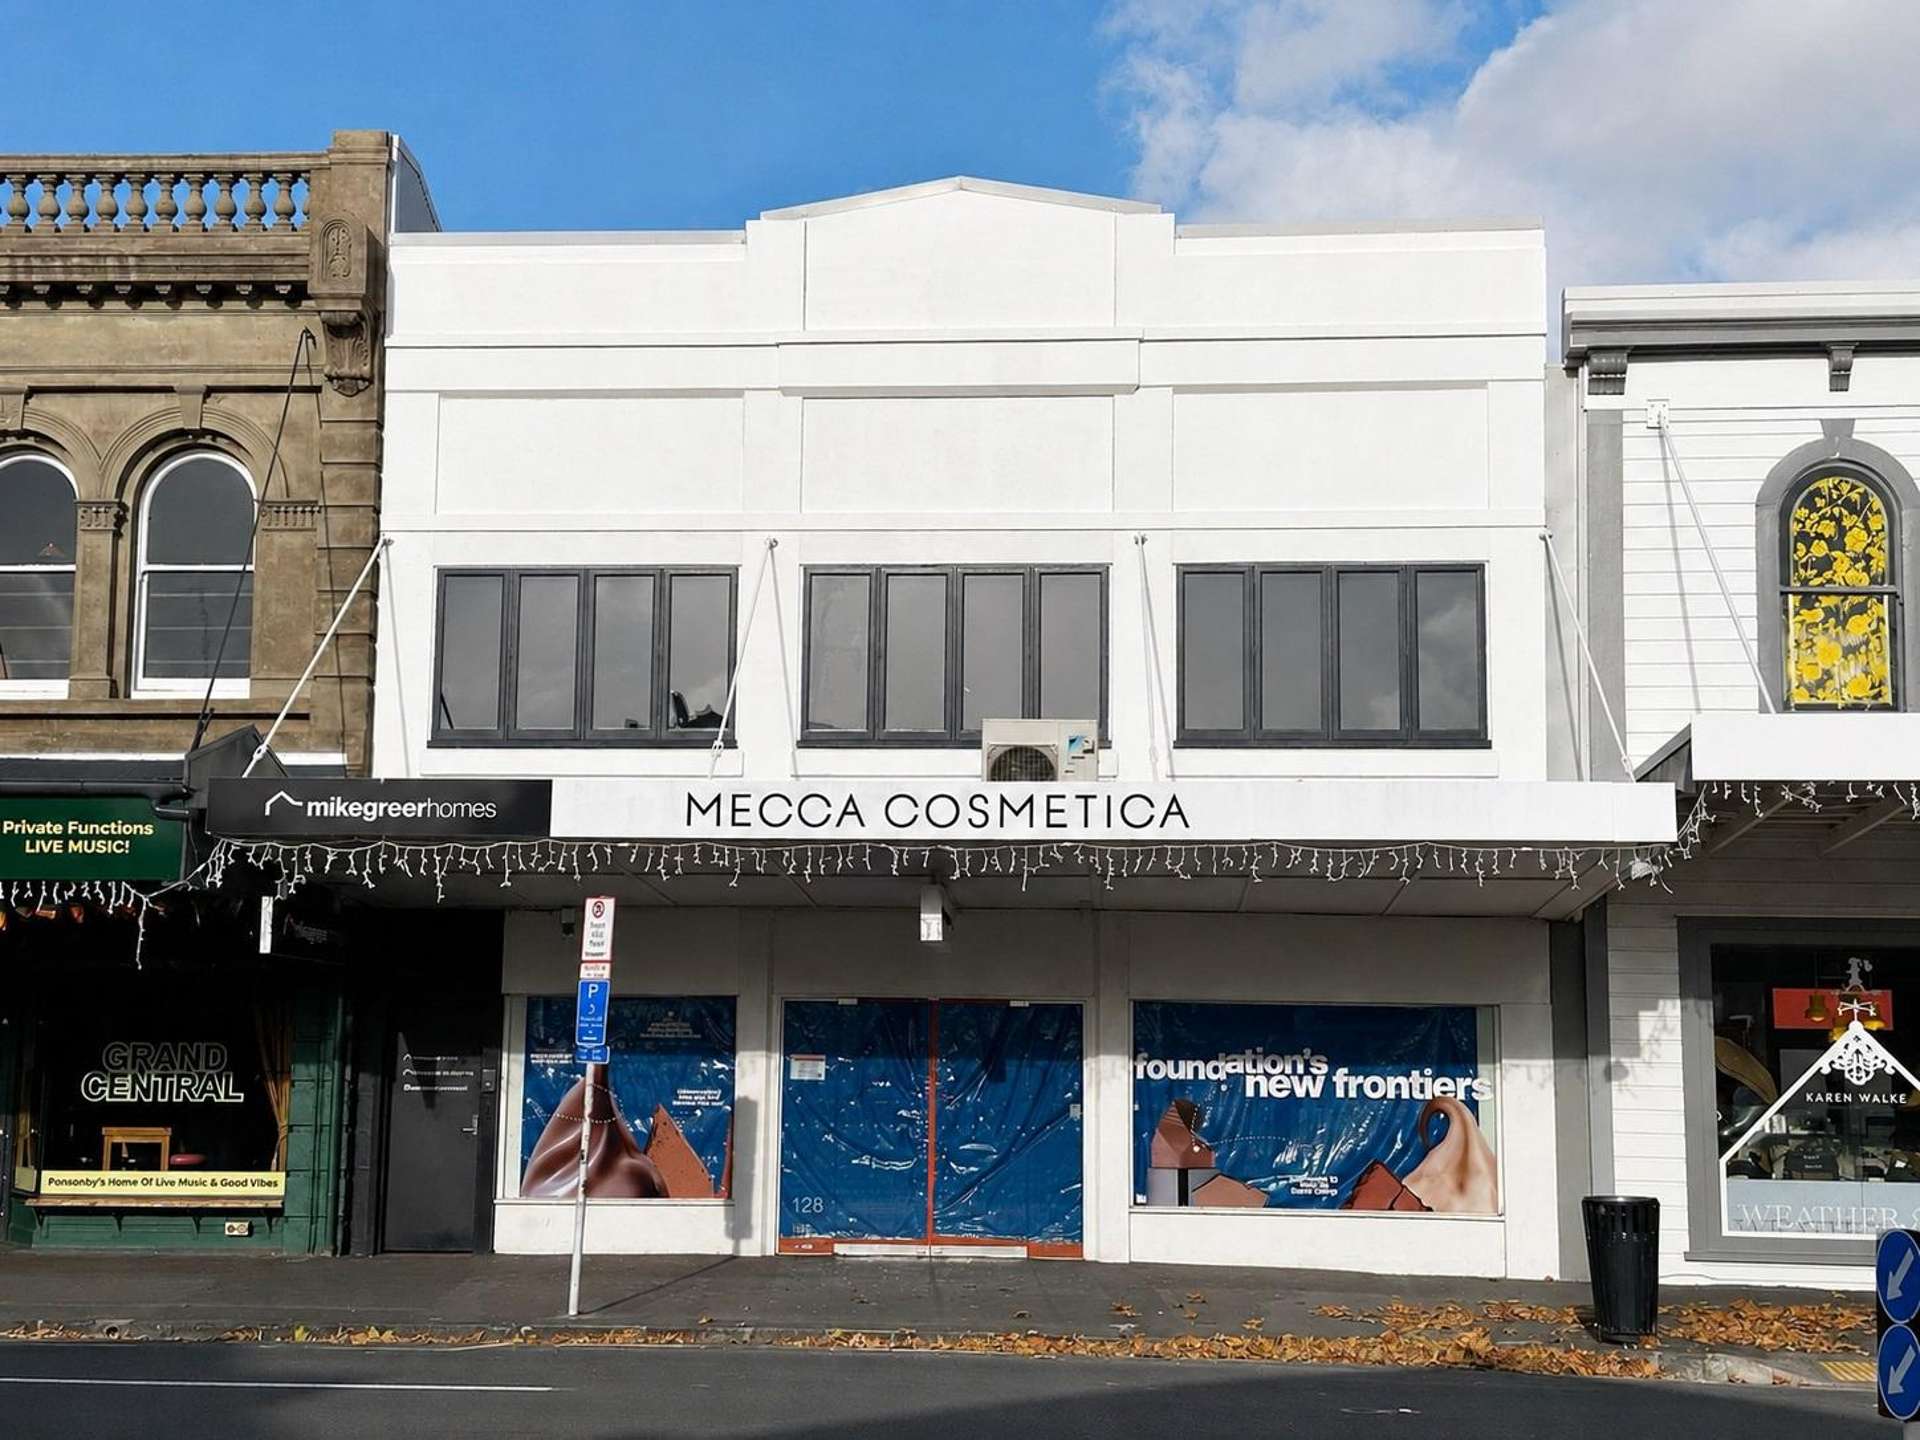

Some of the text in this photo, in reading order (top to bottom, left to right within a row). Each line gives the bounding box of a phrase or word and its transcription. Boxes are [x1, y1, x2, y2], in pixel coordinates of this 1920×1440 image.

[307, 796, 497, 821] mikegreerhomes
[686, 792, 1190, 829] MECCA COSMETICA
[3, 820, 154, 835] Private Functions
[25, 840, 130, 854] LIVE MUSIC!
[588, 984, 599, 998] P
[102, 1042, 228, 1073] GRAND
[1134, 1046, 1329, 1082] foundation's
[81, 1071, 244, 1103] CENTRAL
[1245, 1067, 1493, 1101] new frontiers
[1805, 1092, 1852, 1103] KAREN
[48, 1177, 278, 1188] Ponsonby's Home Of Live Music & Good Vibes
[792, 1196, 825, 1213] 128
[1737, 1203, 1904, 1230] WEATHER
